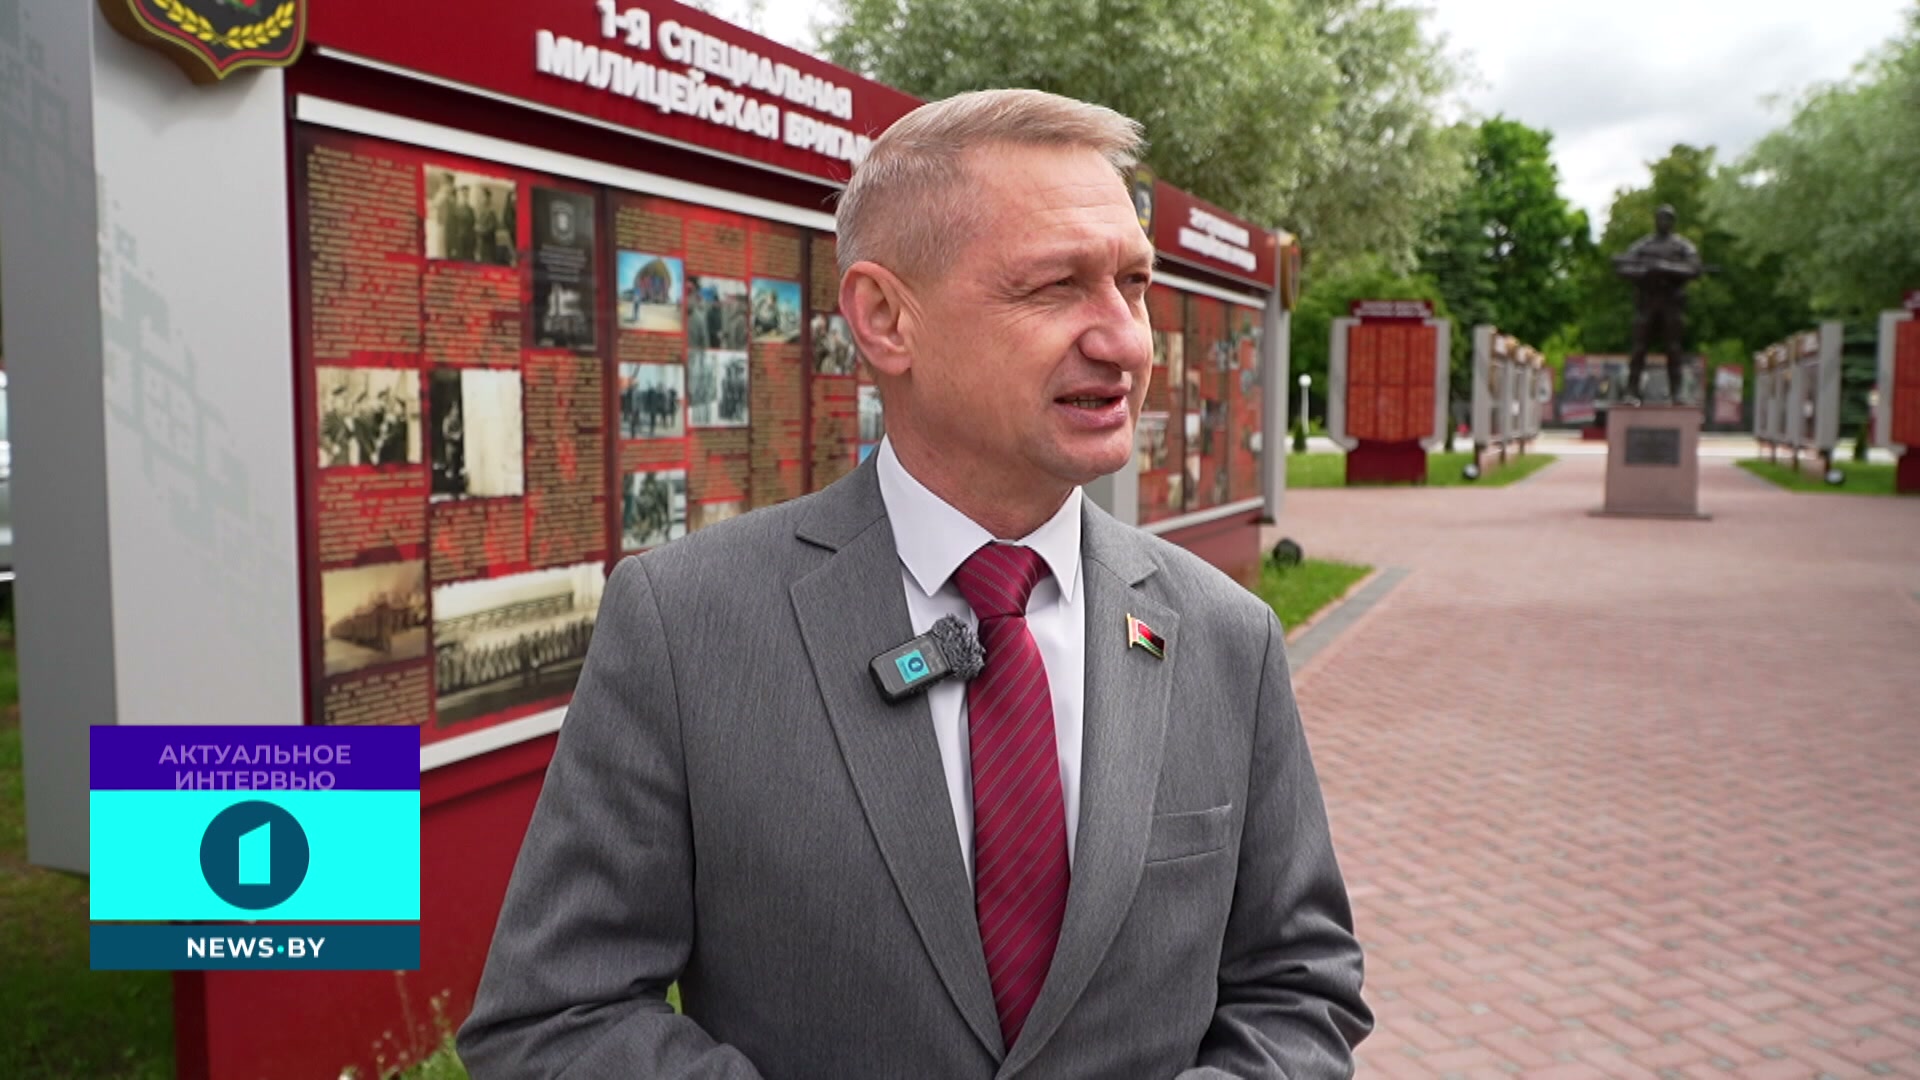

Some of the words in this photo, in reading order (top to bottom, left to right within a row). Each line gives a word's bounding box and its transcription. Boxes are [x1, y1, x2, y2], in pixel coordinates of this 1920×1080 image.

[536, 29, 779, 140] МИЛИЦЕЙСКАЯ
[597, 0, 651, 50] 1-Я
[657, 20, 852, 120] СПЕЦИАЛЬНАЯ
